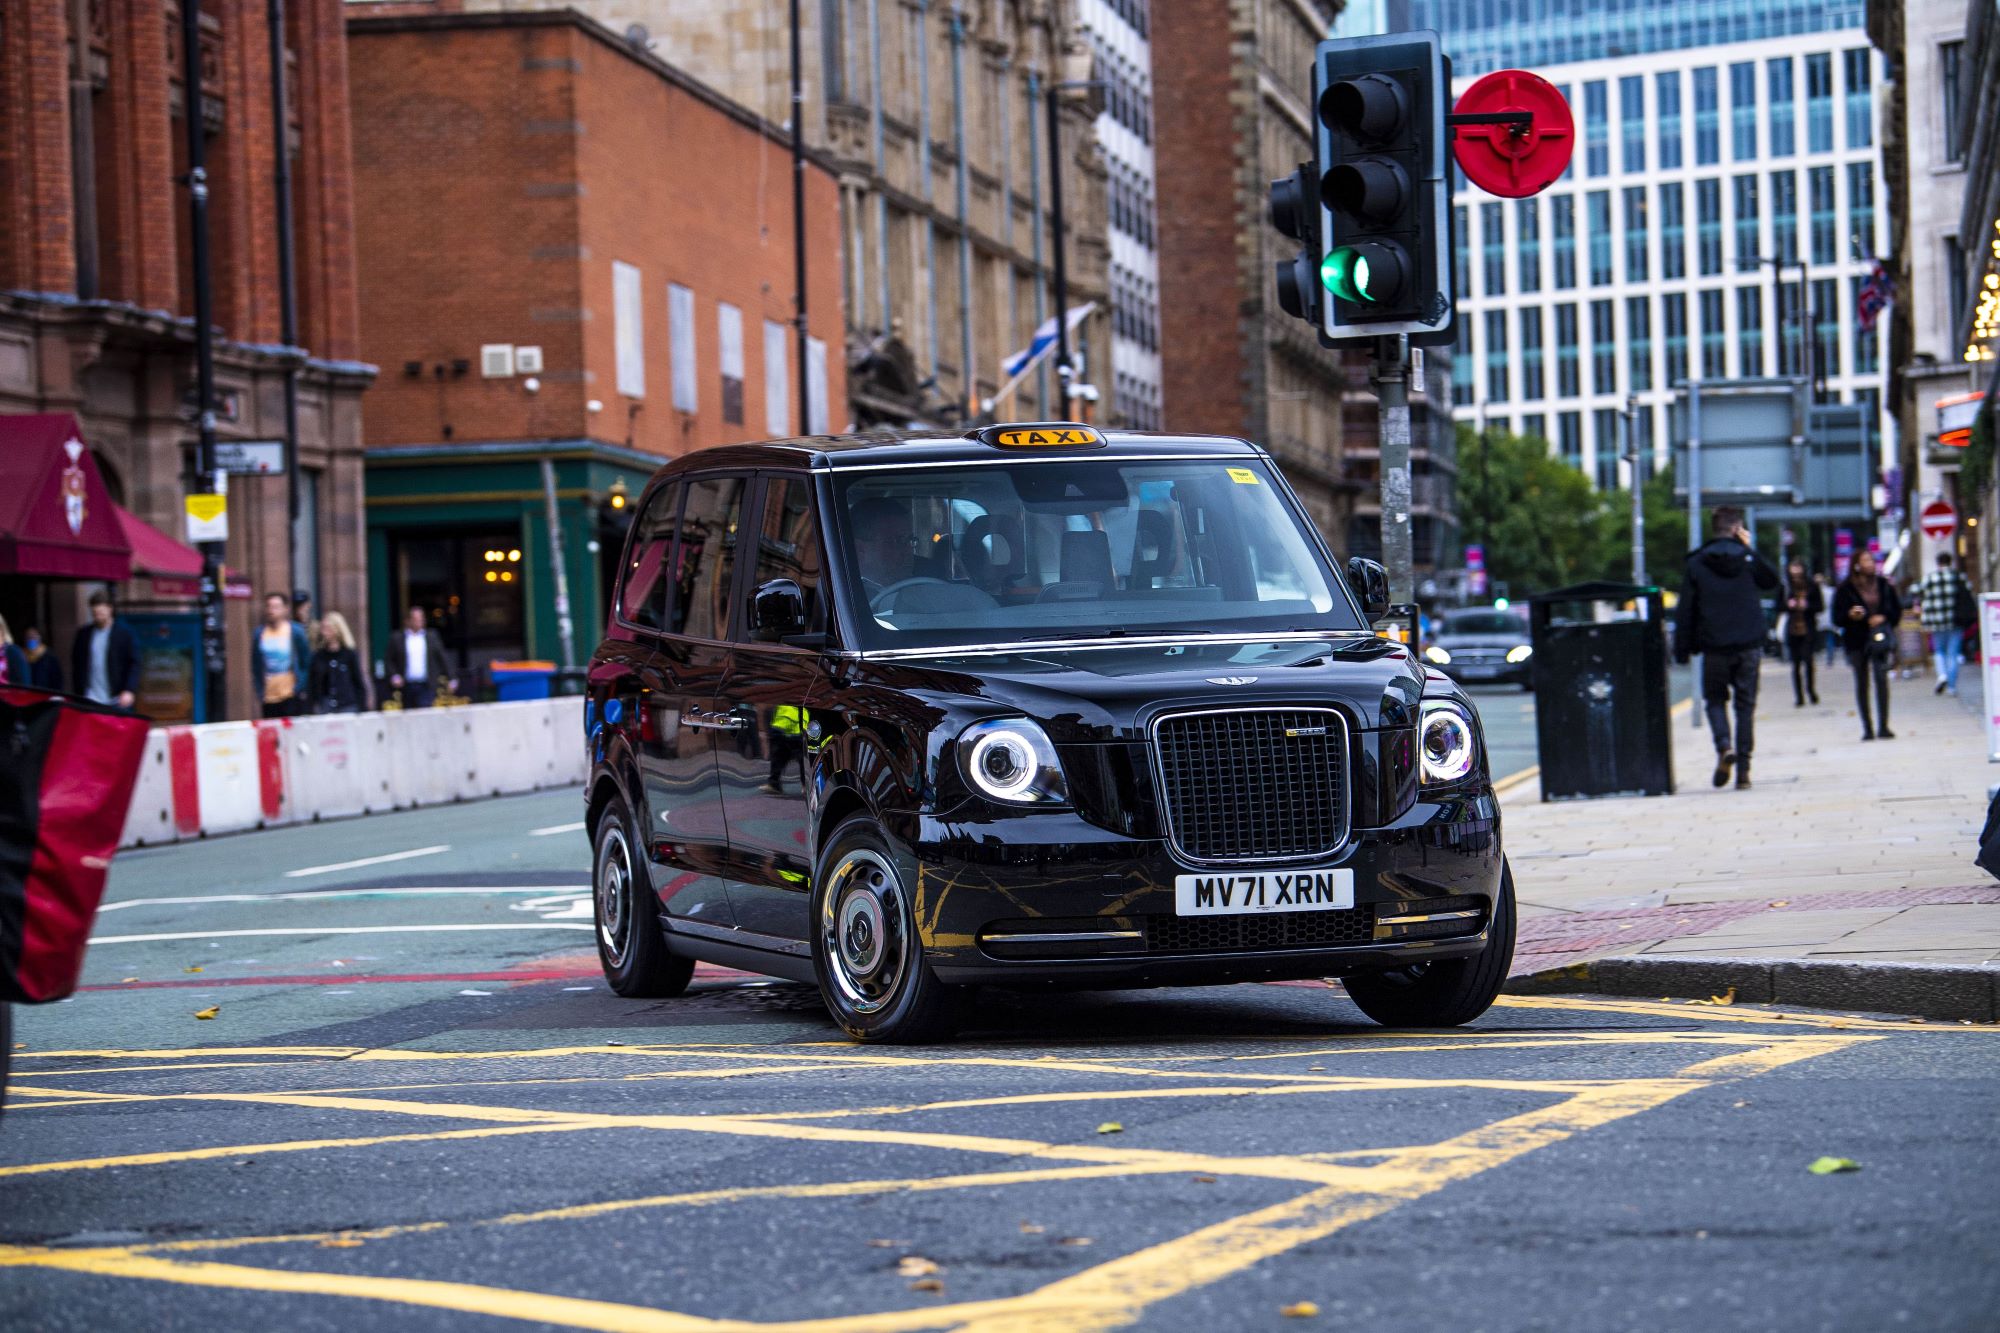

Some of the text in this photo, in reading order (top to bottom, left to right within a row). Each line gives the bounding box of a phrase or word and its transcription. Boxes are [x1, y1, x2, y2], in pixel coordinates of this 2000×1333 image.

[1006, 431, 1089, 444] TAXI
[1195, 873, 1334, 908] MV71 XRN
